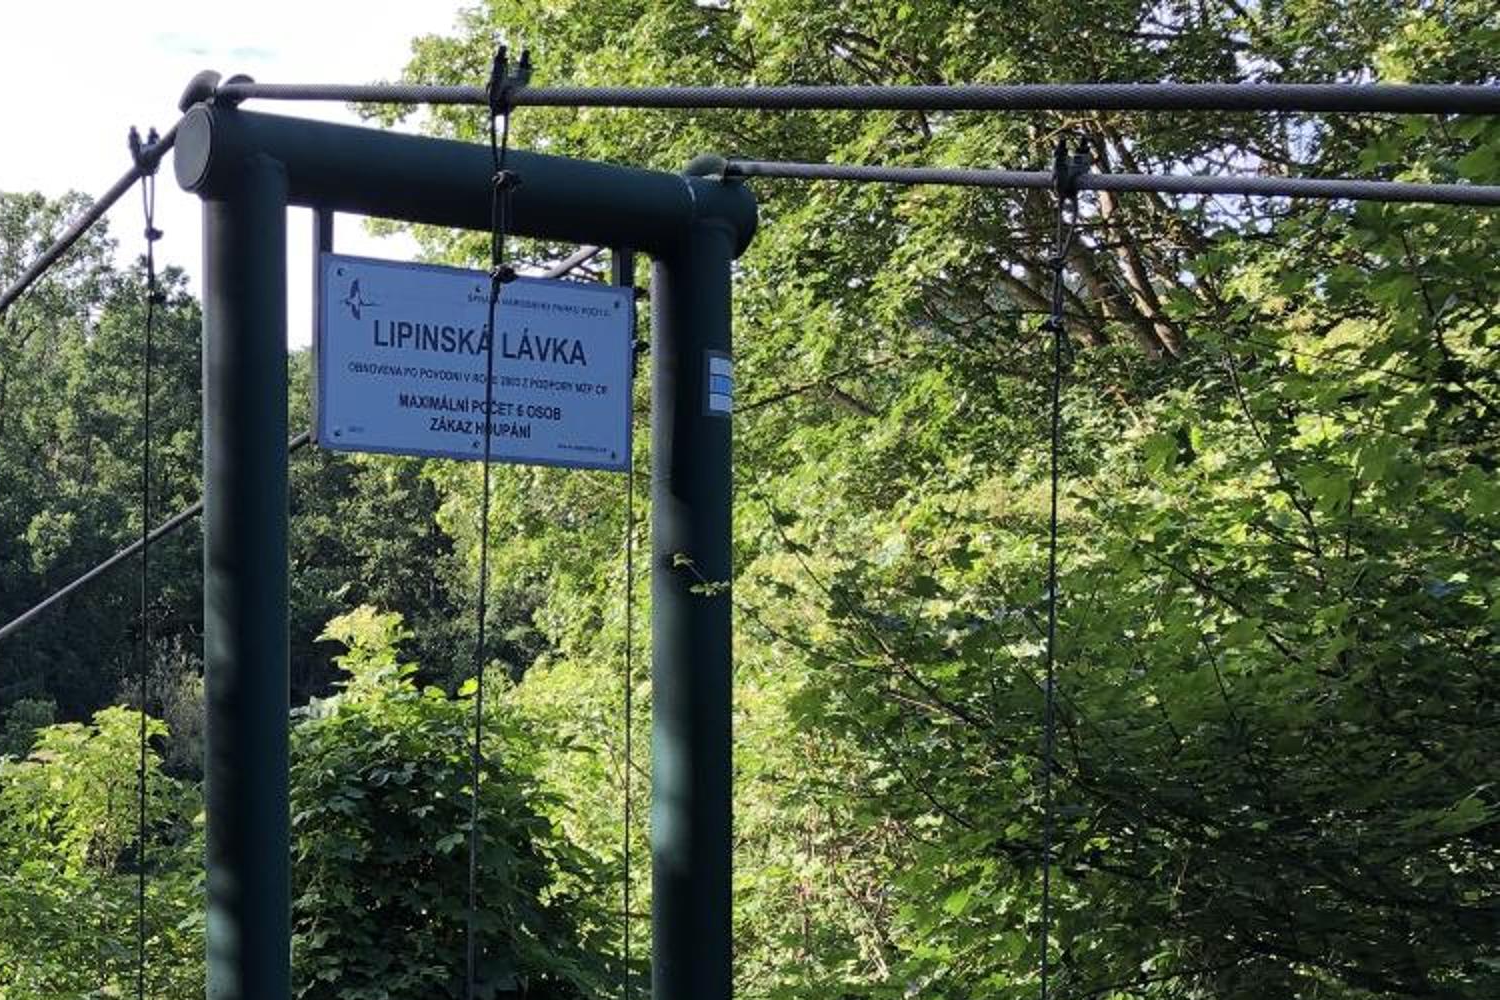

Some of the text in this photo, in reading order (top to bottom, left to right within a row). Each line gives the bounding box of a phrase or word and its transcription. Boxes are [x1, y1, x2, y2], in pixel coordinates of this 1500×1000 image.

[374, 319, 587, 366] LIPINSKÁ LÁVKA
[399, 392, 469, 412] MAXIMÁLNÍ
[471, 399, 514, 416] POČET
[527, 405, 561, 420] OSOB
[430, 416, 472, 433] ZÁKAZ
